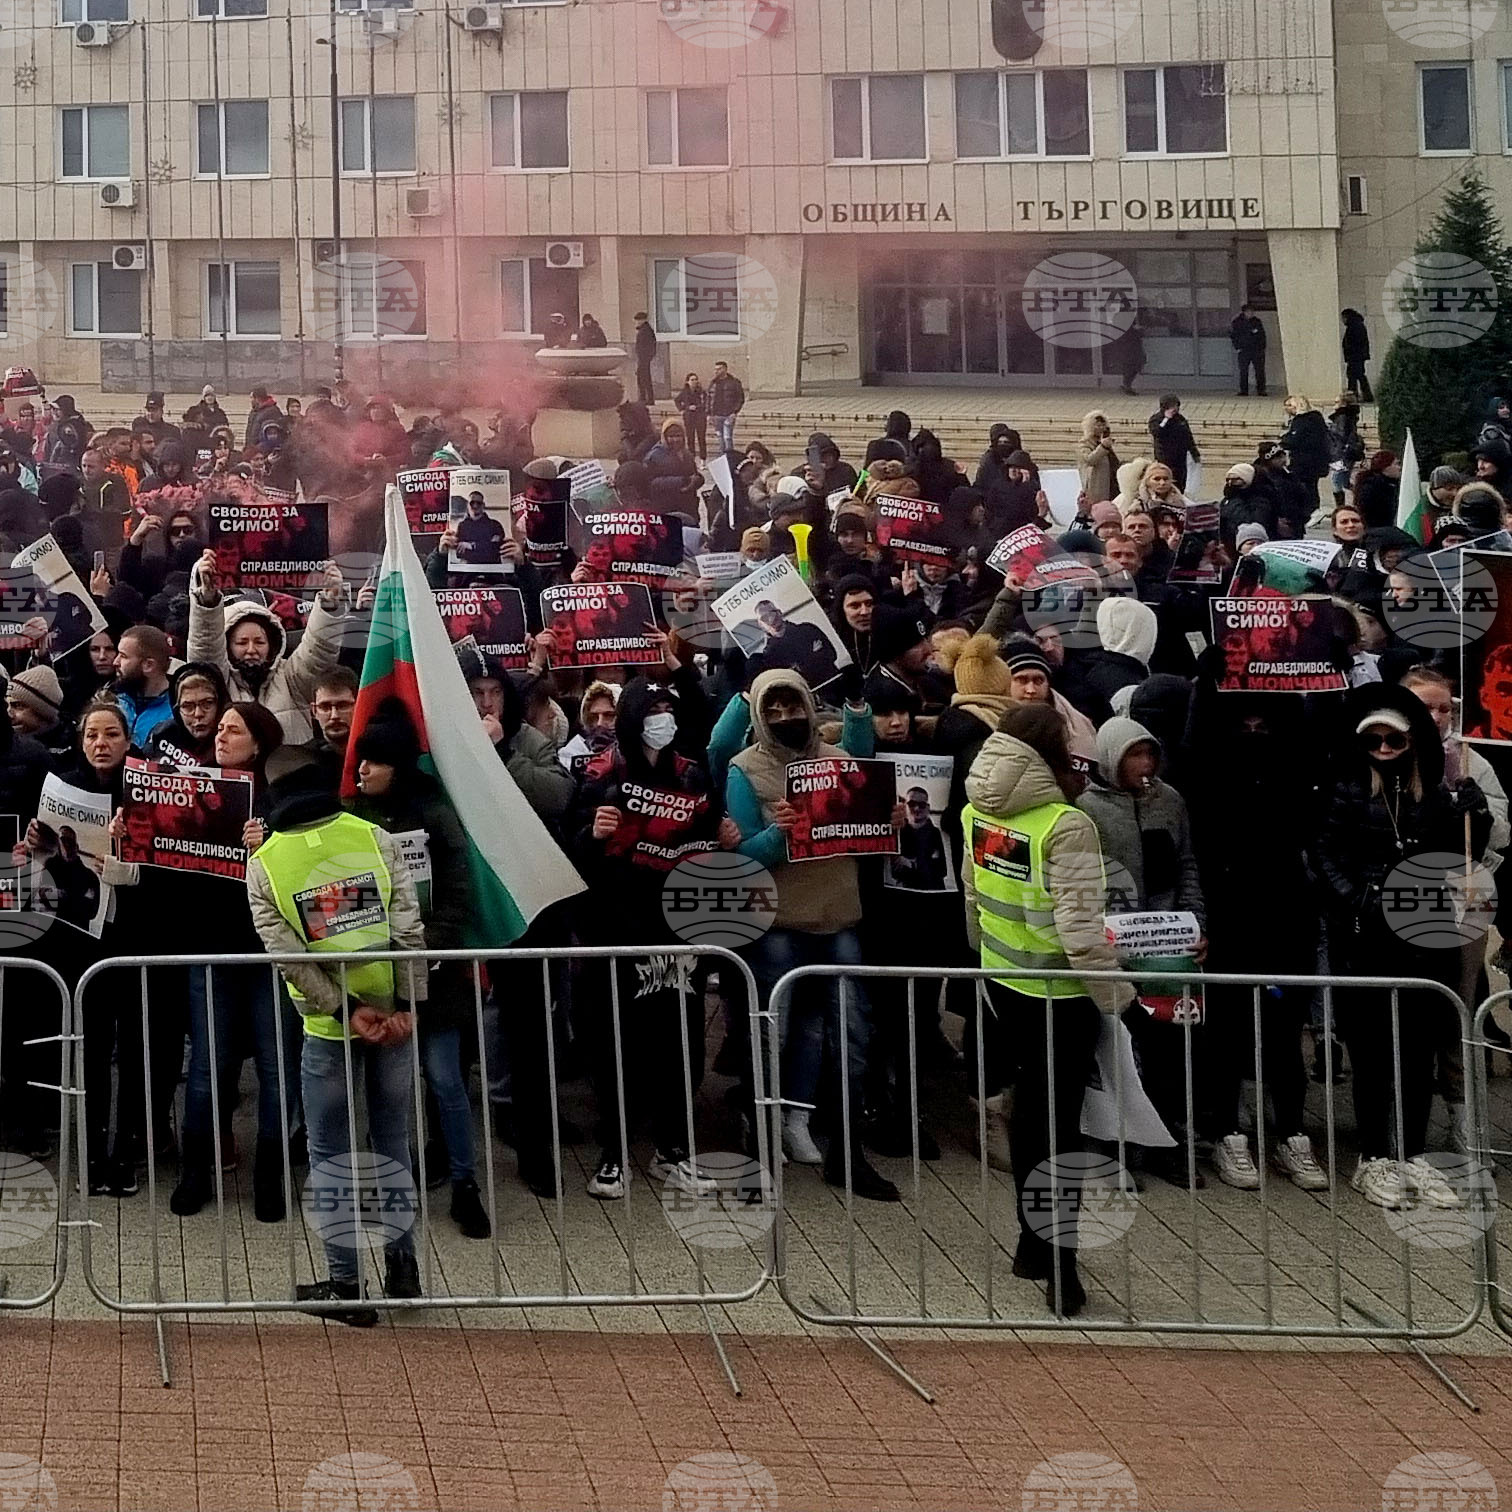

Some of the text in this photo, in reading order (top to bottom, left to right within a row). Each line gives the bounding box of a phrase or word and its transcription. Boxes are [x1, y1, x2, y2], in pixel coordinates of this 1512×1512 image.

[802, 197, 1262, 227] ОБЩИНА ТЪРГОВИЩЕ
[400, 472, 445, 484] СВОБОДА
[405, 480, 448, 492] СИМО!
[876, 496, 940, 514] СВОБОДА ЗА
[211, 506, 299, 519] СВОБОДА ЗА
[584, 513, 662, 525] СВОБОДА ЗА
[880, 506, 923, 521] СИМО!
[219, 519, 279, 532] СИМО!
[591, 523, 646, 535] СИМО!
[480, 590, 496, 601] ЗА
[543, 585, 624, 600] СВОБОДА ЗА
[717, 607, 726, 618] С
[723, 594, 741, 612] ТЕБ
[760, 560, 793, 587] СИМО!
[440, 603, 481, 616] ИМО!
[552, 598, 607, 612] СИМО!
[1215, 600, 1308, 613] СВОБОДА ЗА
[1226, 614, 1288, 628] СИМО!
[788, 760, 860, 778] СВОБОДА ЗА
[1072, 758, 1089, 772] ЗА
[125, 771, 216, 794] СВОБОДА ЗА
[792, 775, 838, 793] СИМО!
[131, 788, 194, 807] СИМО!
[621, 782, 695, 810] СВОБОДА
[627, 798, 693, 822] СИМО!
[154, 836, 245, 861] СПРАВЕДЛИВОСТ
